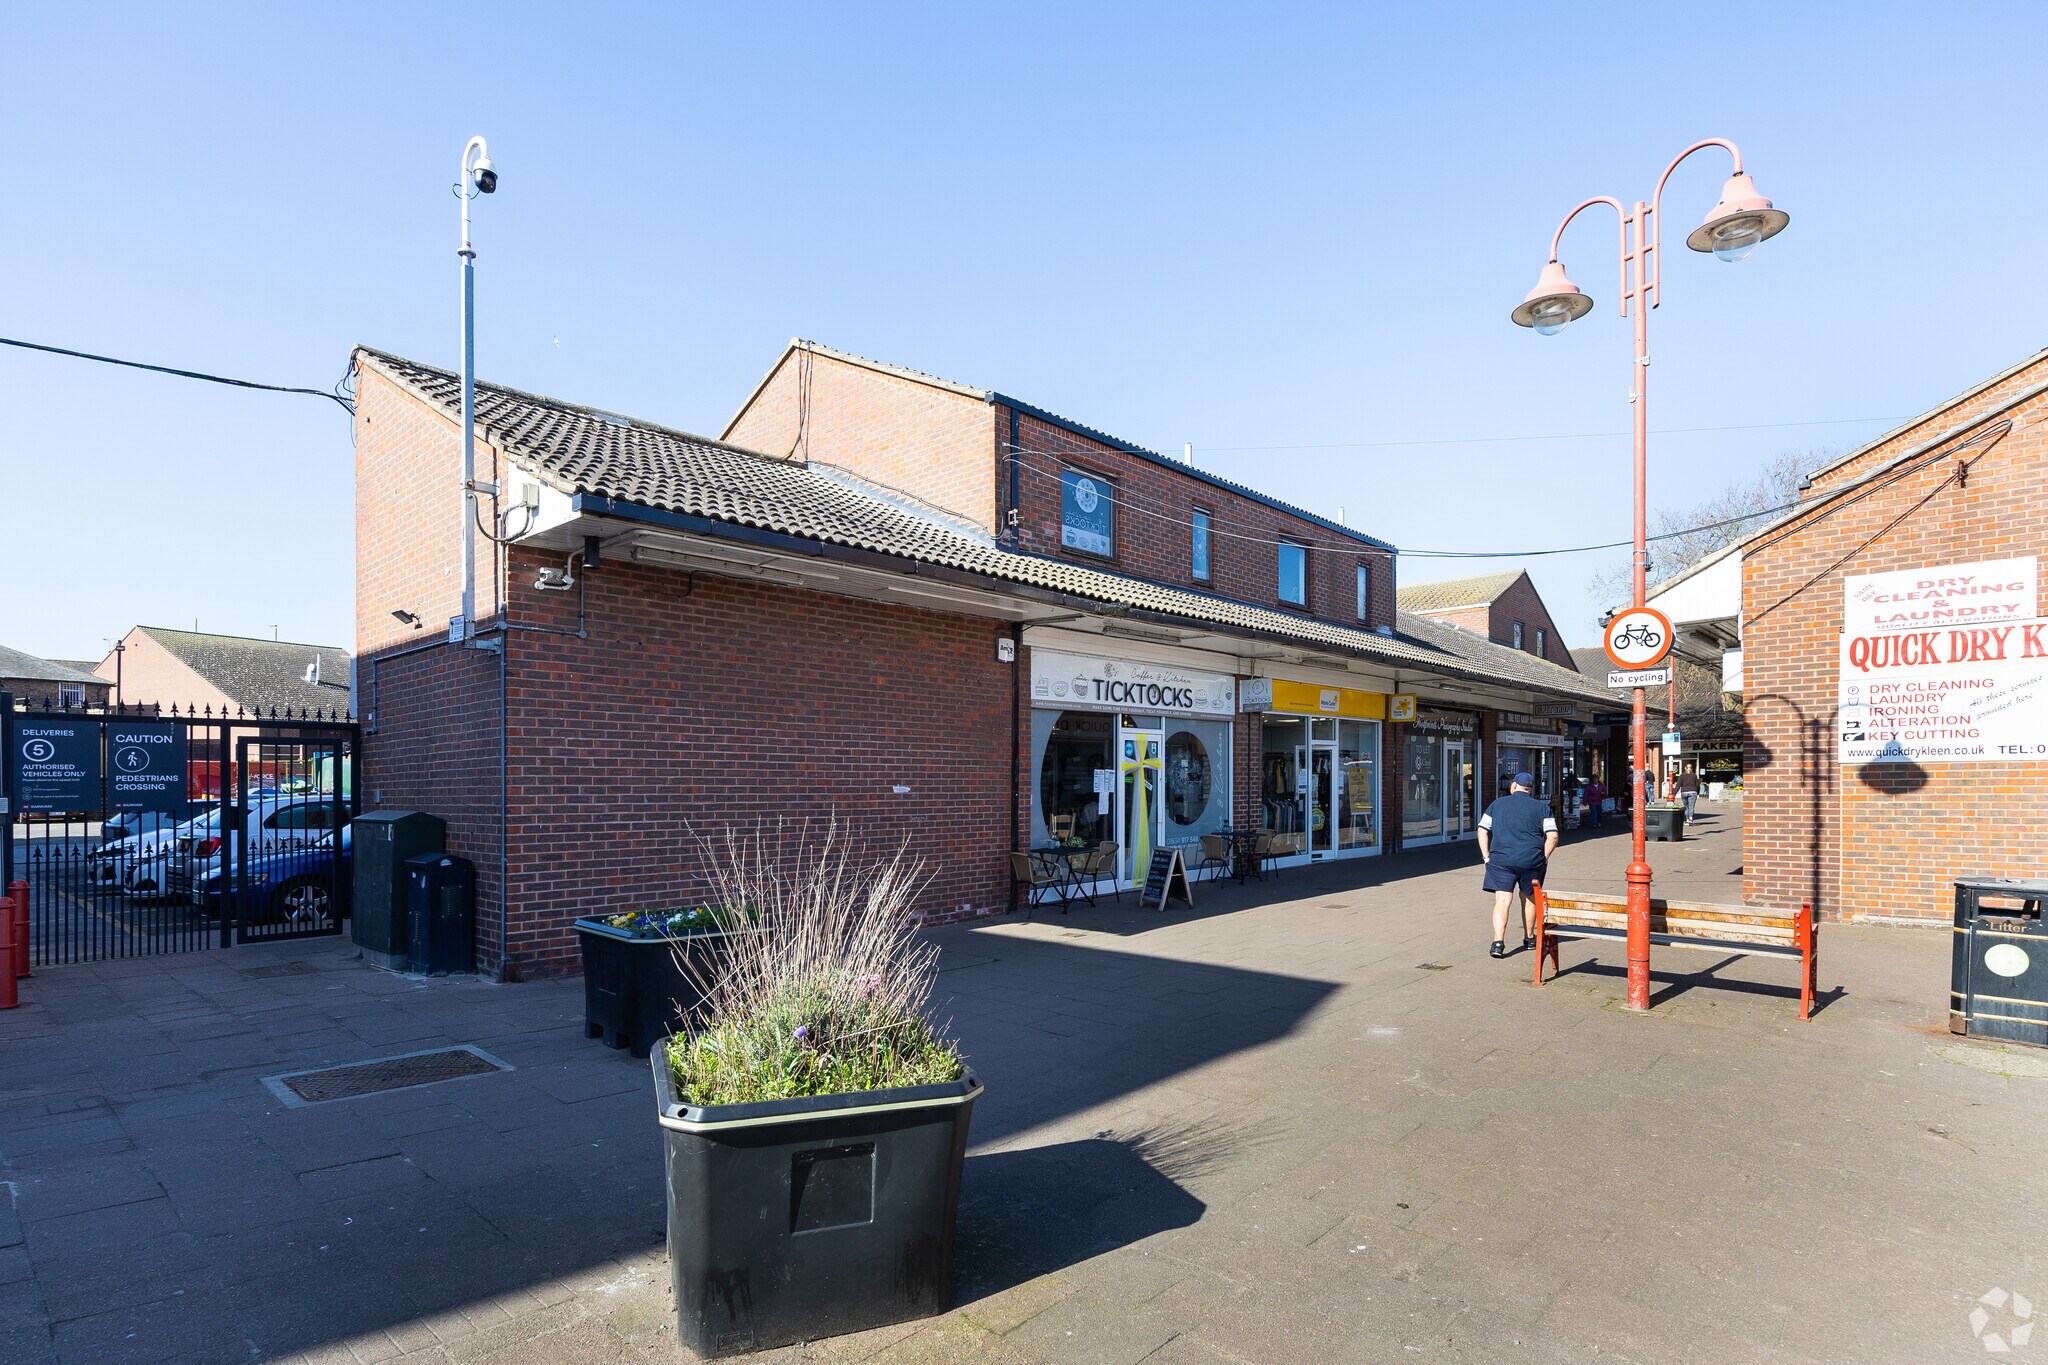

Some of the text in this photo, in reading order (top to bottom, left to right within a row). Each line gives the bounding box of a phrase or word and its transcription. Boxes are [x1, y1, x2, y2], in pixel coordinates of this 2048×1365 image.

[1917, 575, 1976, 589] DRY
[1852, 582, 1875, 599] SAME
[1861, 589, 1877, 602] DAY
[1874, 581, 2025, 603] CLEANING
[1932, 599, 1950, 608] &
[1874, 603, 2020, 623] LAUNDRY
[1876, 614, 2020, 629] QUALITY ALTERATIONS
[1848, 631, 1942, 673] QUICK
[1946, 625, 2014, 664] DRY
[1130, 667, 1154, 681] Coffee
[1162, 671, 1192, 684] Kitchen
[1610, 673, 1663, 683] No cycling
[1870, 678, 1995, 694] DRY CLEANING
[1986, 689, 2007, 702] these
[2011, 674, 2043, 692] services
[1092, 679, 1193, 708] TICKTOCKS
[1869, 692, 1947, 705] LAUNDRY
[1869, 704, 1939, 717] IRONING
[1977, 692, 2034, 720] provided here
[1869, 715, 1971, 728] ALTERATION
[22, 729, 75, 737] DELIVERIES
[115, 734, 173, 744] CAUTION
[1868, 728, 1980, 741] KEY CUTTING
[32, 744, 45, 756] 5
[1692, 741, 1744, 750] BAKERY
[1848, 744, 1985, 759] www.quickdrykleen.co.uk
[115, 774, 179, 782] PEDESTRIANS
[1989, 922, 2028, 934] Litter
